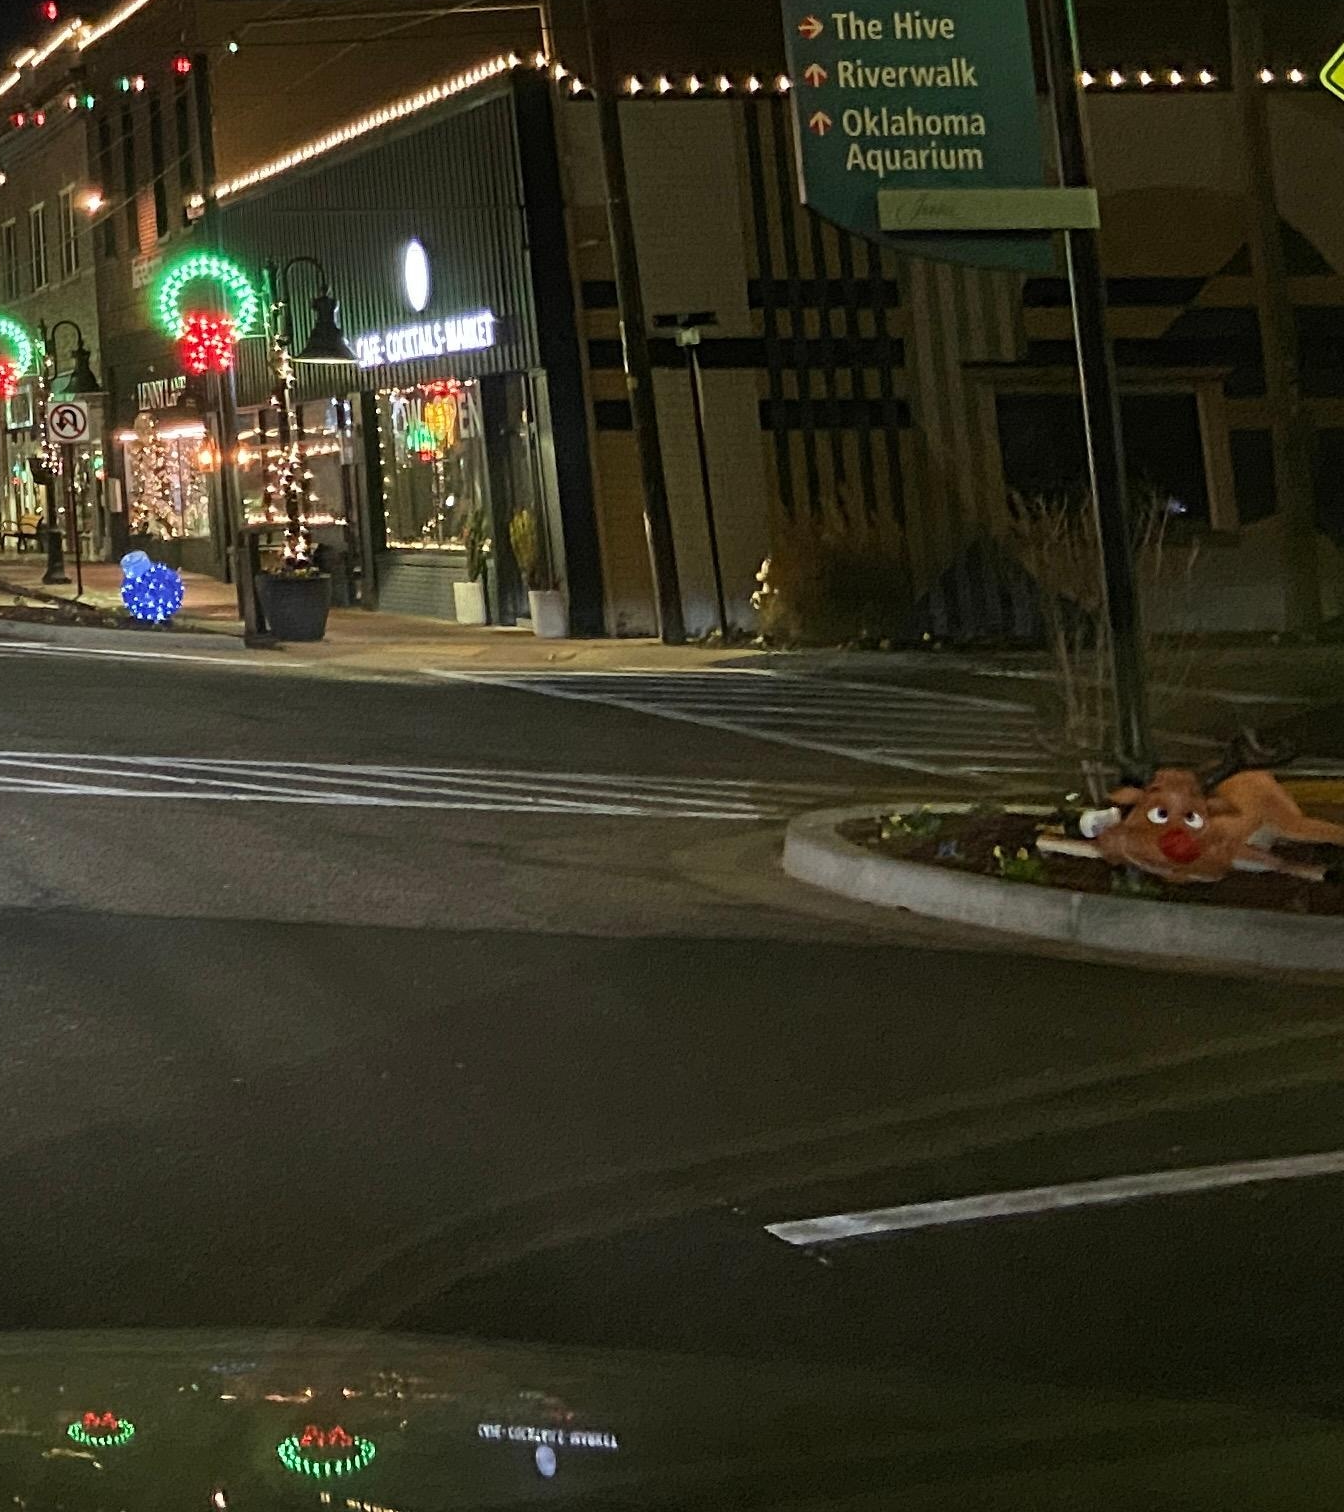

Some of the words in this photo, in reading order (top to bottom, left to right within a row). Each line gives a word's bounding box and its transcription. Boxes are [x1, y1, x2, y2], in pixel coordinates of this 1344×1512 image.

[832, 11, 882, 40] The
[894, 11, 954, 39] Hive
[838, 58, 977, 87] Riverwalk
[843, 106, 985, 136] Oklahoma
[847, 141, 983, 178] Aquarium
